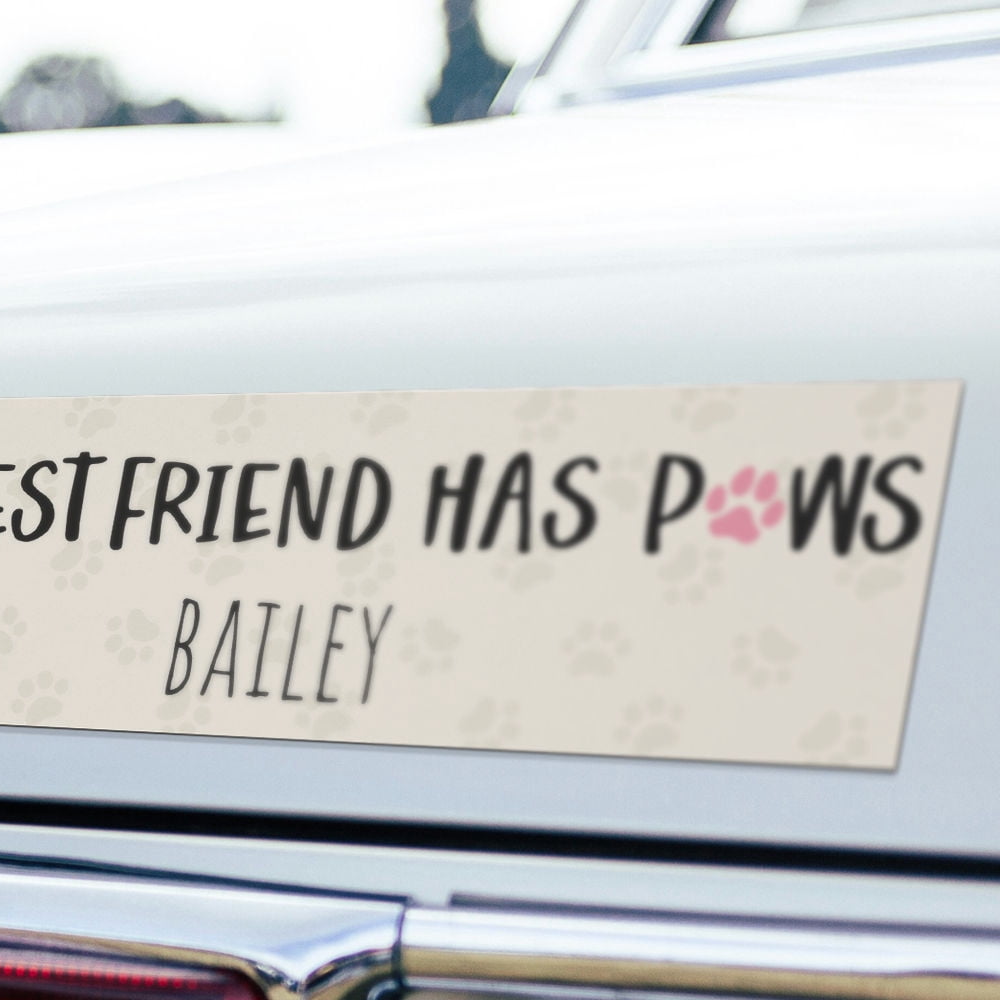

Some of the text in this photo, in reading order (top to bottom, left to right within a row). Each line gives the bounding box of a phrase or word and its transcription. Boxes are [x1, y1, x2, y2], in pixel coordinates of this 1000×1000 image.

[108, 456, 393, 551] FRIEND
[423, 451, 600, 554] HAS
[164, 597, 393, 705] BAILEY
